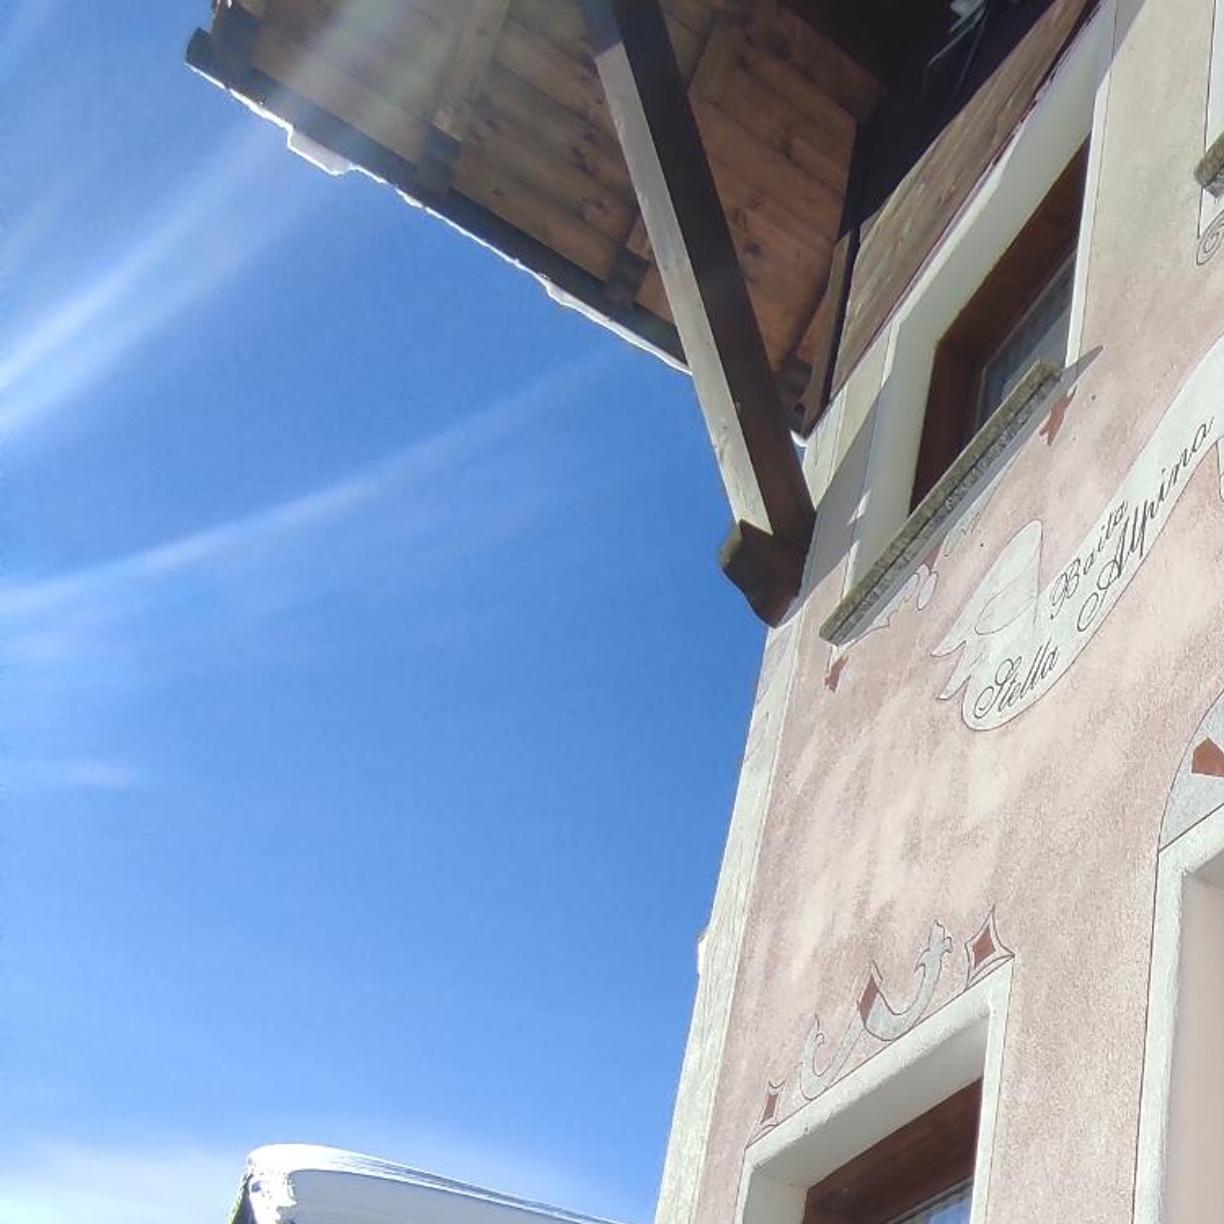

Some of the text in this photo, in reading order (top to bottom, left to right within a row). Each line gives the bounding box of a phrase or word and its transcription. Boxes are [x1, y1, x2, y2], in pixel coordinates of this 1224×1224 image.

[974, 416, 1214, 719] Stella Alpina
[1049, 500, 1128, 620] Baita
